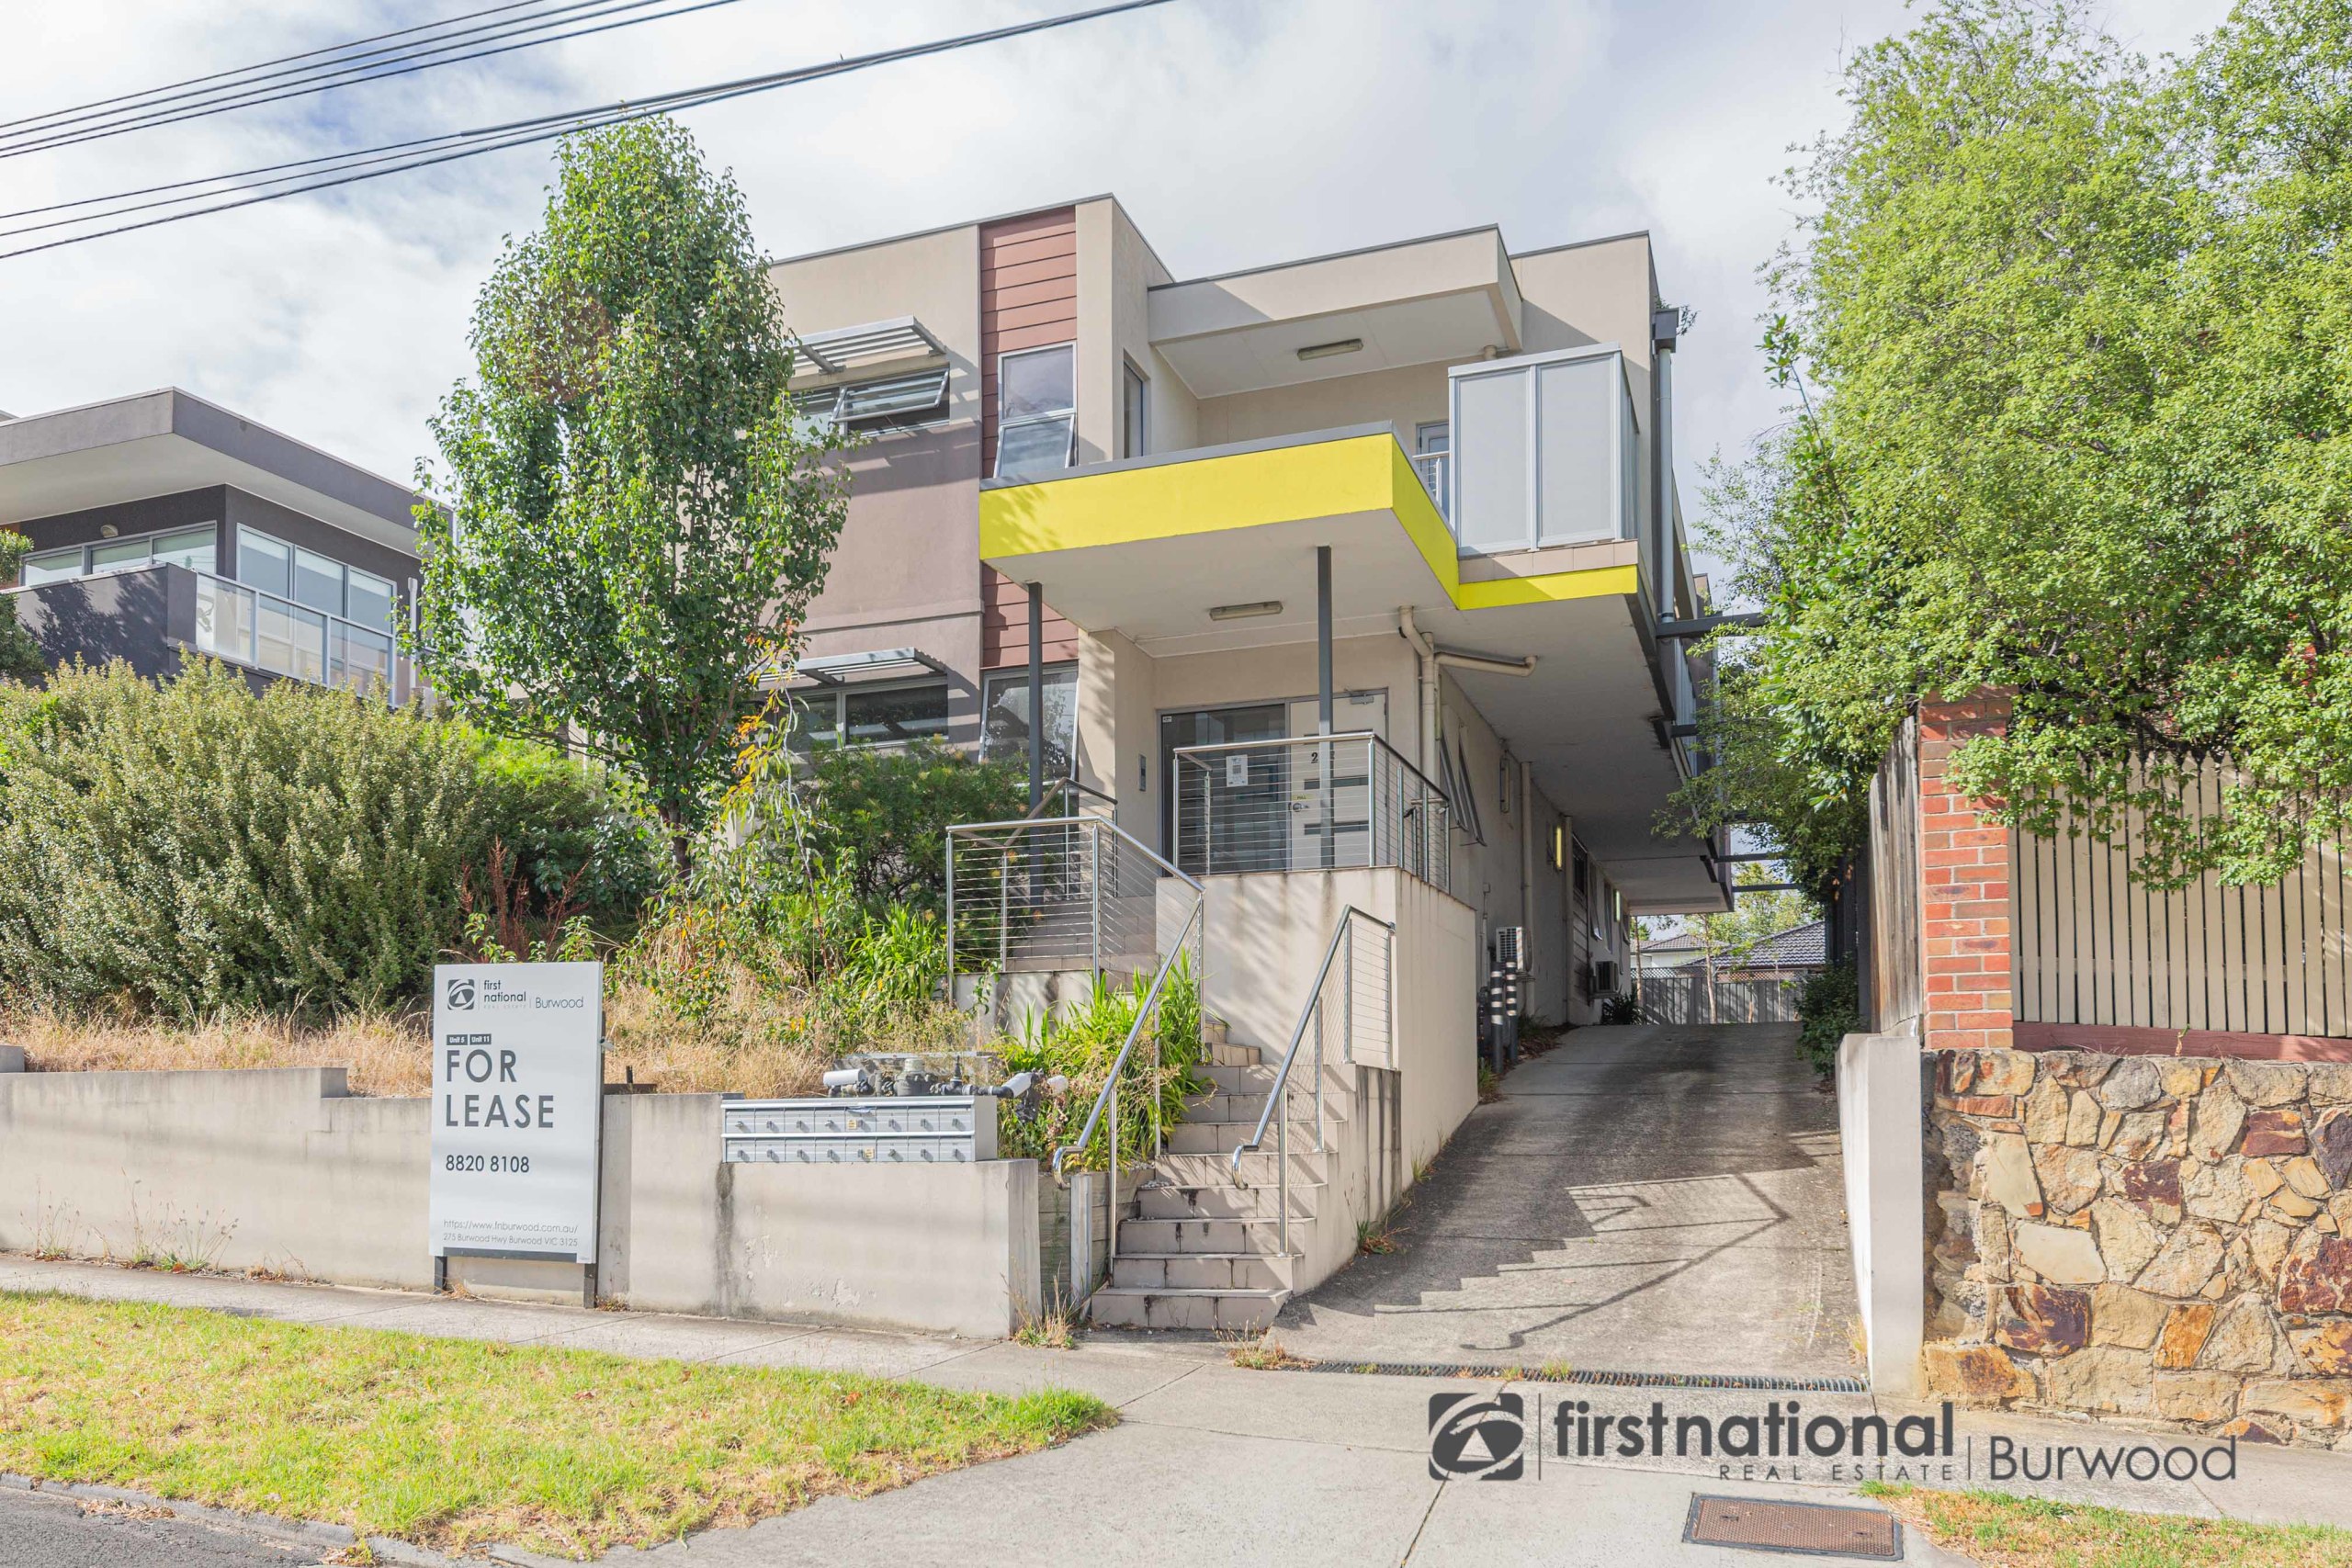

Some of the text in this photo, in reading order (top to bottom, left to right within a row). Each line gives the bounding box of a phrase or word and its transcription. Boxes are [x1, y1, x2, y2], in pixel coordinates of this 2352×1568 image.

[483, 980, 502, 990] first
[483, 991, 526, 1002] national
[535, 997, 584, 1009] Burwood
[447, 1049, 517, 1083] FOR
[446, 1094, 554, 1129] LEASE
[446, 1155, 530, 1173] 8820 8108
[443, 1219, 578, 1234] https://www.fnburwood.com.au/
[443, 1233, 578, 1247] 275 Burwood Hwy Burwood VIC 3125
